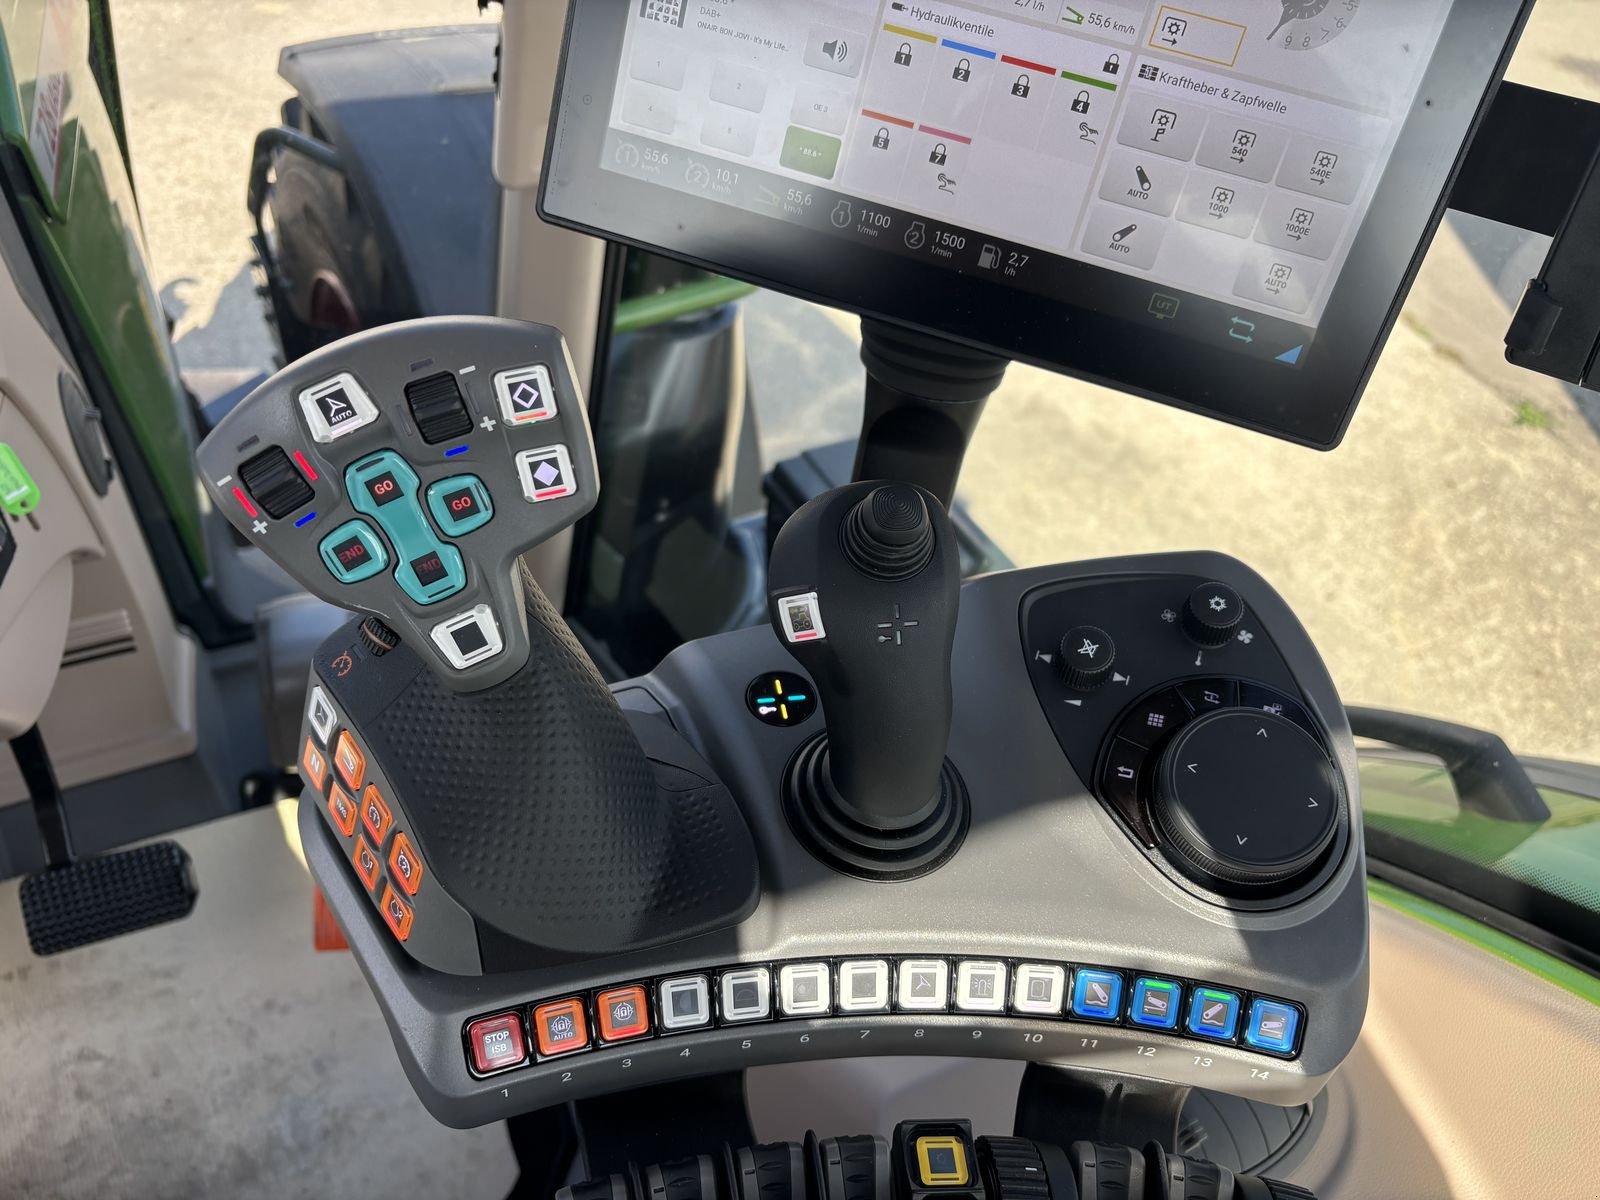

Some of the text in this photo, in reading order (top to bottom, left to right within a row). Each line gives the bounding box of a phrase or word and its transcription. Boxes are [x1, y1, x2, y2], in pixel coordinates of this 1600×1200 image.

[700, 6, 721, 19] DAB+
[910, 6, 995, 38] Hydraulikventile
[1088, 12, 1136, 36] 55,6 km/h
[719, 27, 734, 37] BON
[733, 32, 750, 41] JOVI
[763, 39, 772, 49] My
[1302, 36, 1311, 48] 8
[1158, 71, 1288, 115] Kraftheber & Zapfwelle
[644, 147, 669, 166] 55,6
[1231, 146, 1248, 158] 540
[715, 168, 739, 185] 10,1
[1309, 166, 1332, 180] 540E
[786, 188, 812, 206] 55,6
[1127, 187, 1149, 201] AUTO
[1208, 201, 1229, 214] 1000
[860, 208, 891, 229] 1100
[856, 224, 879, 238] 1/min
[1285, 222, 1311, 237] 1000E
[934, 230, 966, 250] 1500
[930, 245, 953, 259] 1/min
[1109, 241, 1131, 254] AUTO
[1008, 252, 1030, 268] 2,7
[1265, 277, 1288, 290] AUTO
[331, 410, 353, 424] AUTO
[374, 480, 394, 496] GO
[452, 496, 472, 511] GO
[338, 544, 364, 562] END
[311, 753, 321, 773] N
[484, 1031, 510, 1044] STOP
[553, 1031, 573, 1041] AUTO
[800, 1034, 810, 1043] 6
[860, 1030, 871, 1039] 7
[914, 1028, 925, 1038] 8
[971, 1029, 982, 1040] 9
[1023, 1032, 1044, 1044] 10
[491, 1043, 507, 1054] ISB
[741, 1039, 752, 1049] 5
[1080, 1038, 1098, 1048] 11
[679, 1048, 691, 1058] 4
[1136, 1045, 1158, 1057] 12
[622, 1058, 632, 1068] 3
[1193, 1056, 1213, 1068] 13
[561, 1072, 573, 1083] 2
[1250, 1067, 1271, 1081] 14
[501, 1088, 509, 1098] 1
